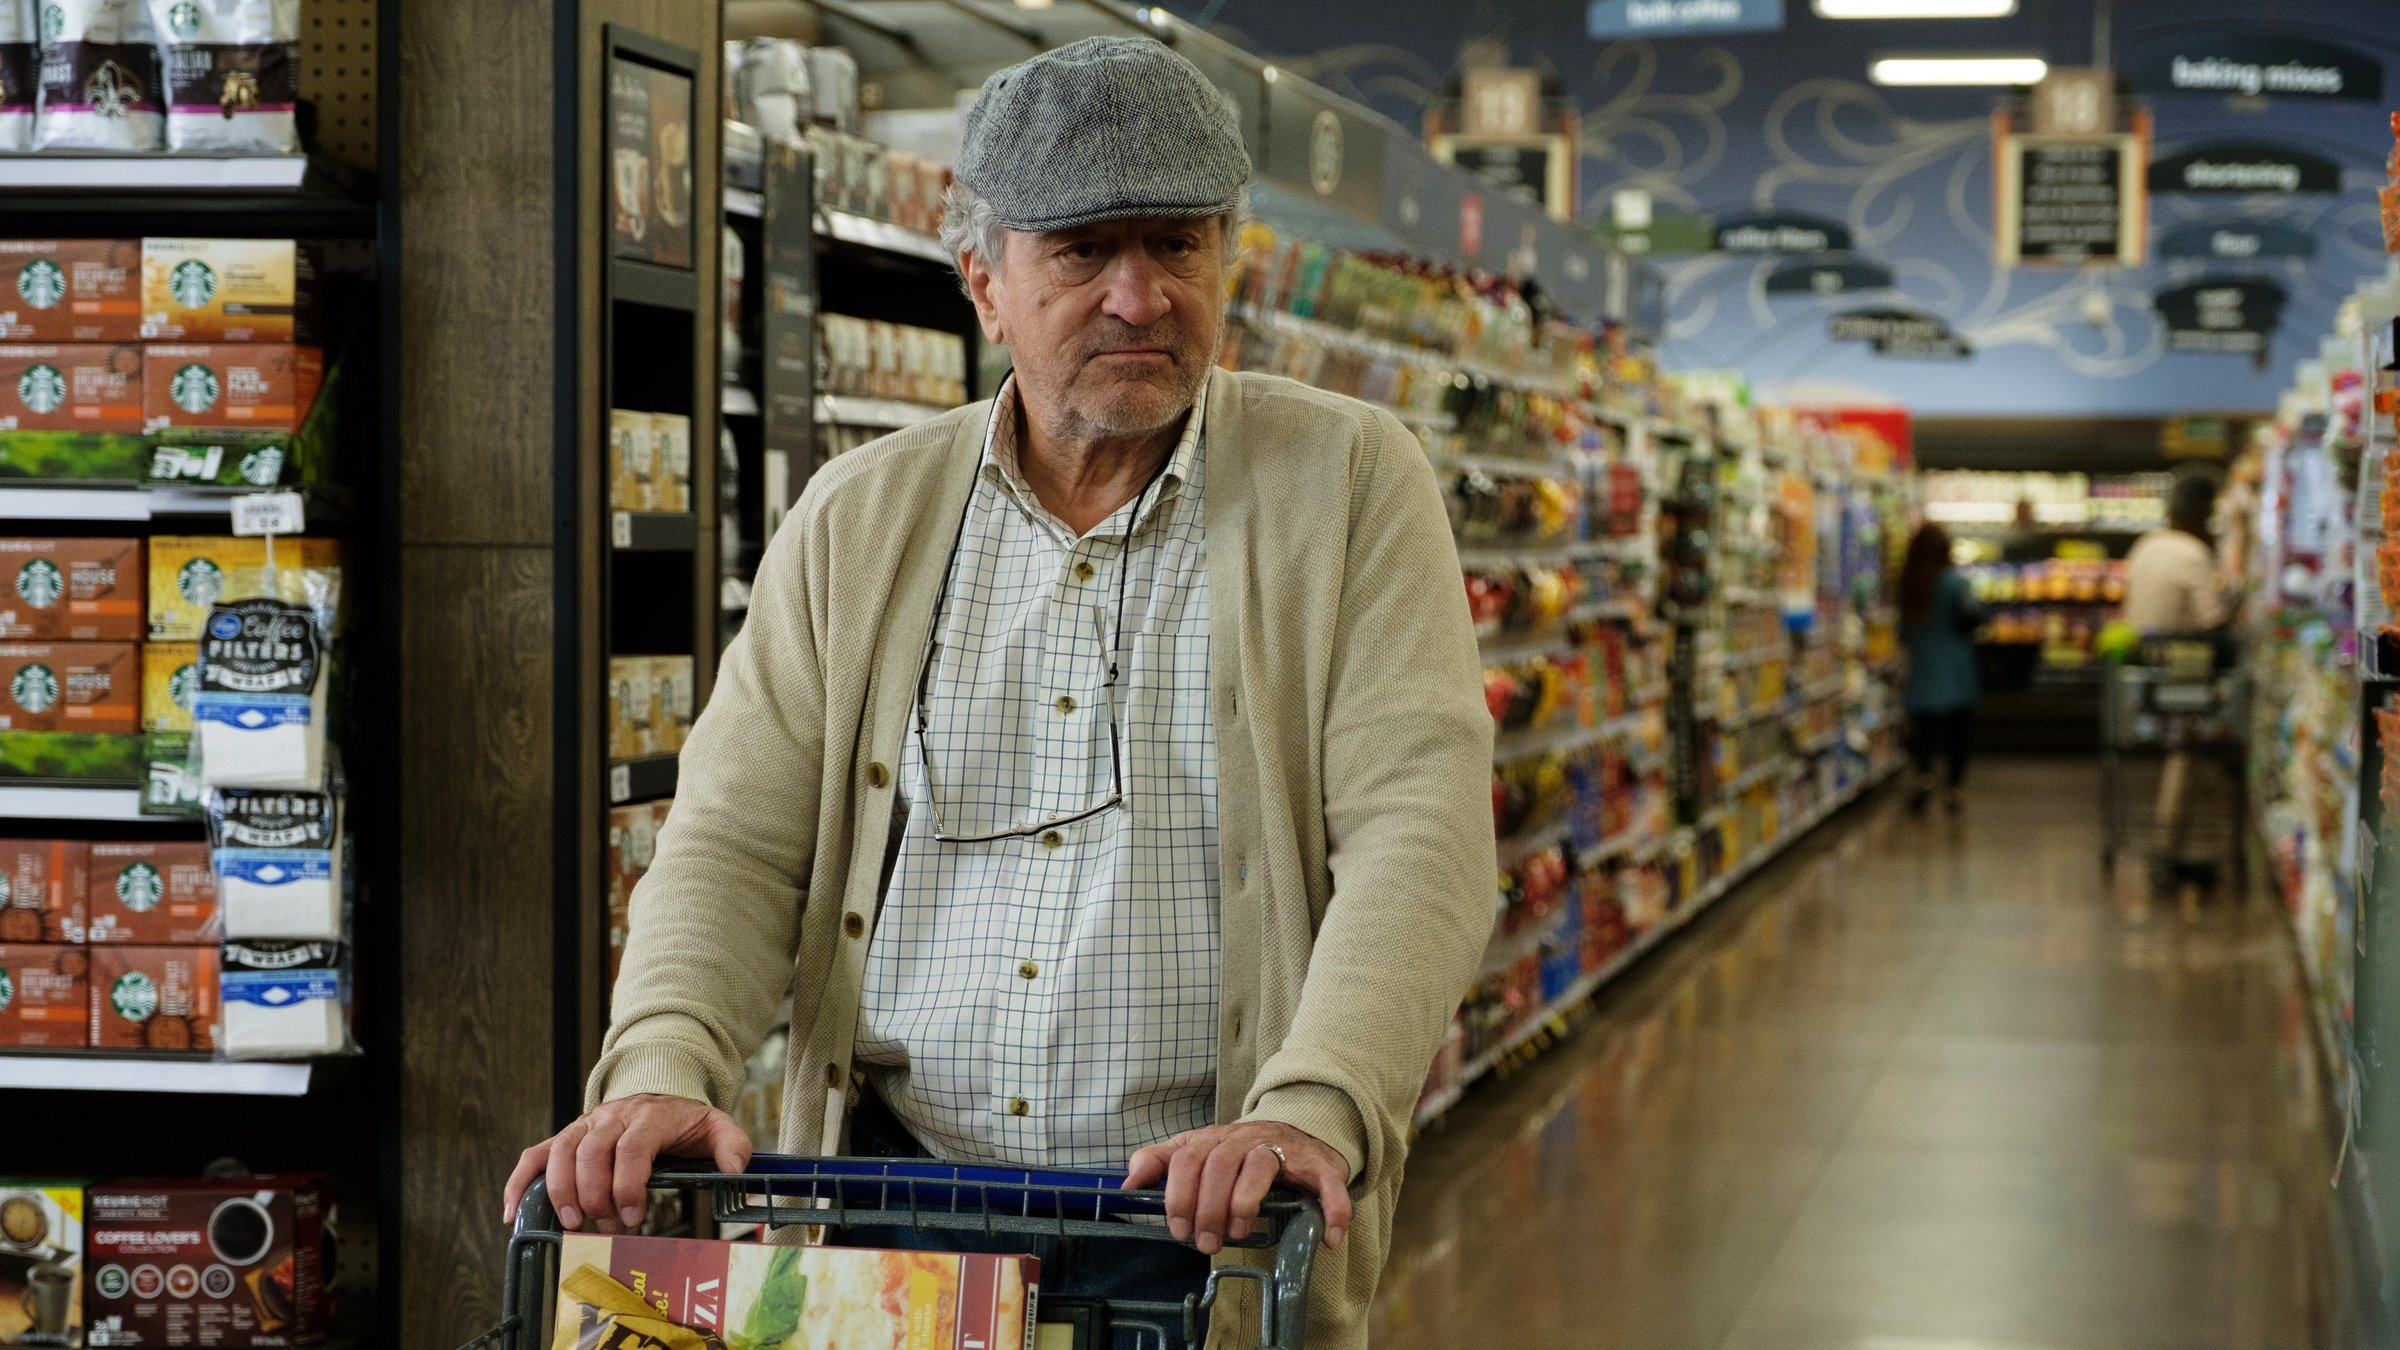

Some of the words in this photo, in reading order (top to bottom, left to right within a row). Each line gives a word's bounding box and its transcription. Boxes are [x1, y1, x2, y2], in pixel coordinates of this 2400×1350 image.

[2171, 55, 2263, 95] baking
[2264, 60, 2343, 94] mixes
[242, 614, 304, 643] Coffee
[208, 640, 303, 661] FILTERS
[224, 797, 320, 816] FILTERS
[94, 1230, 146, 1245] COFFEE
